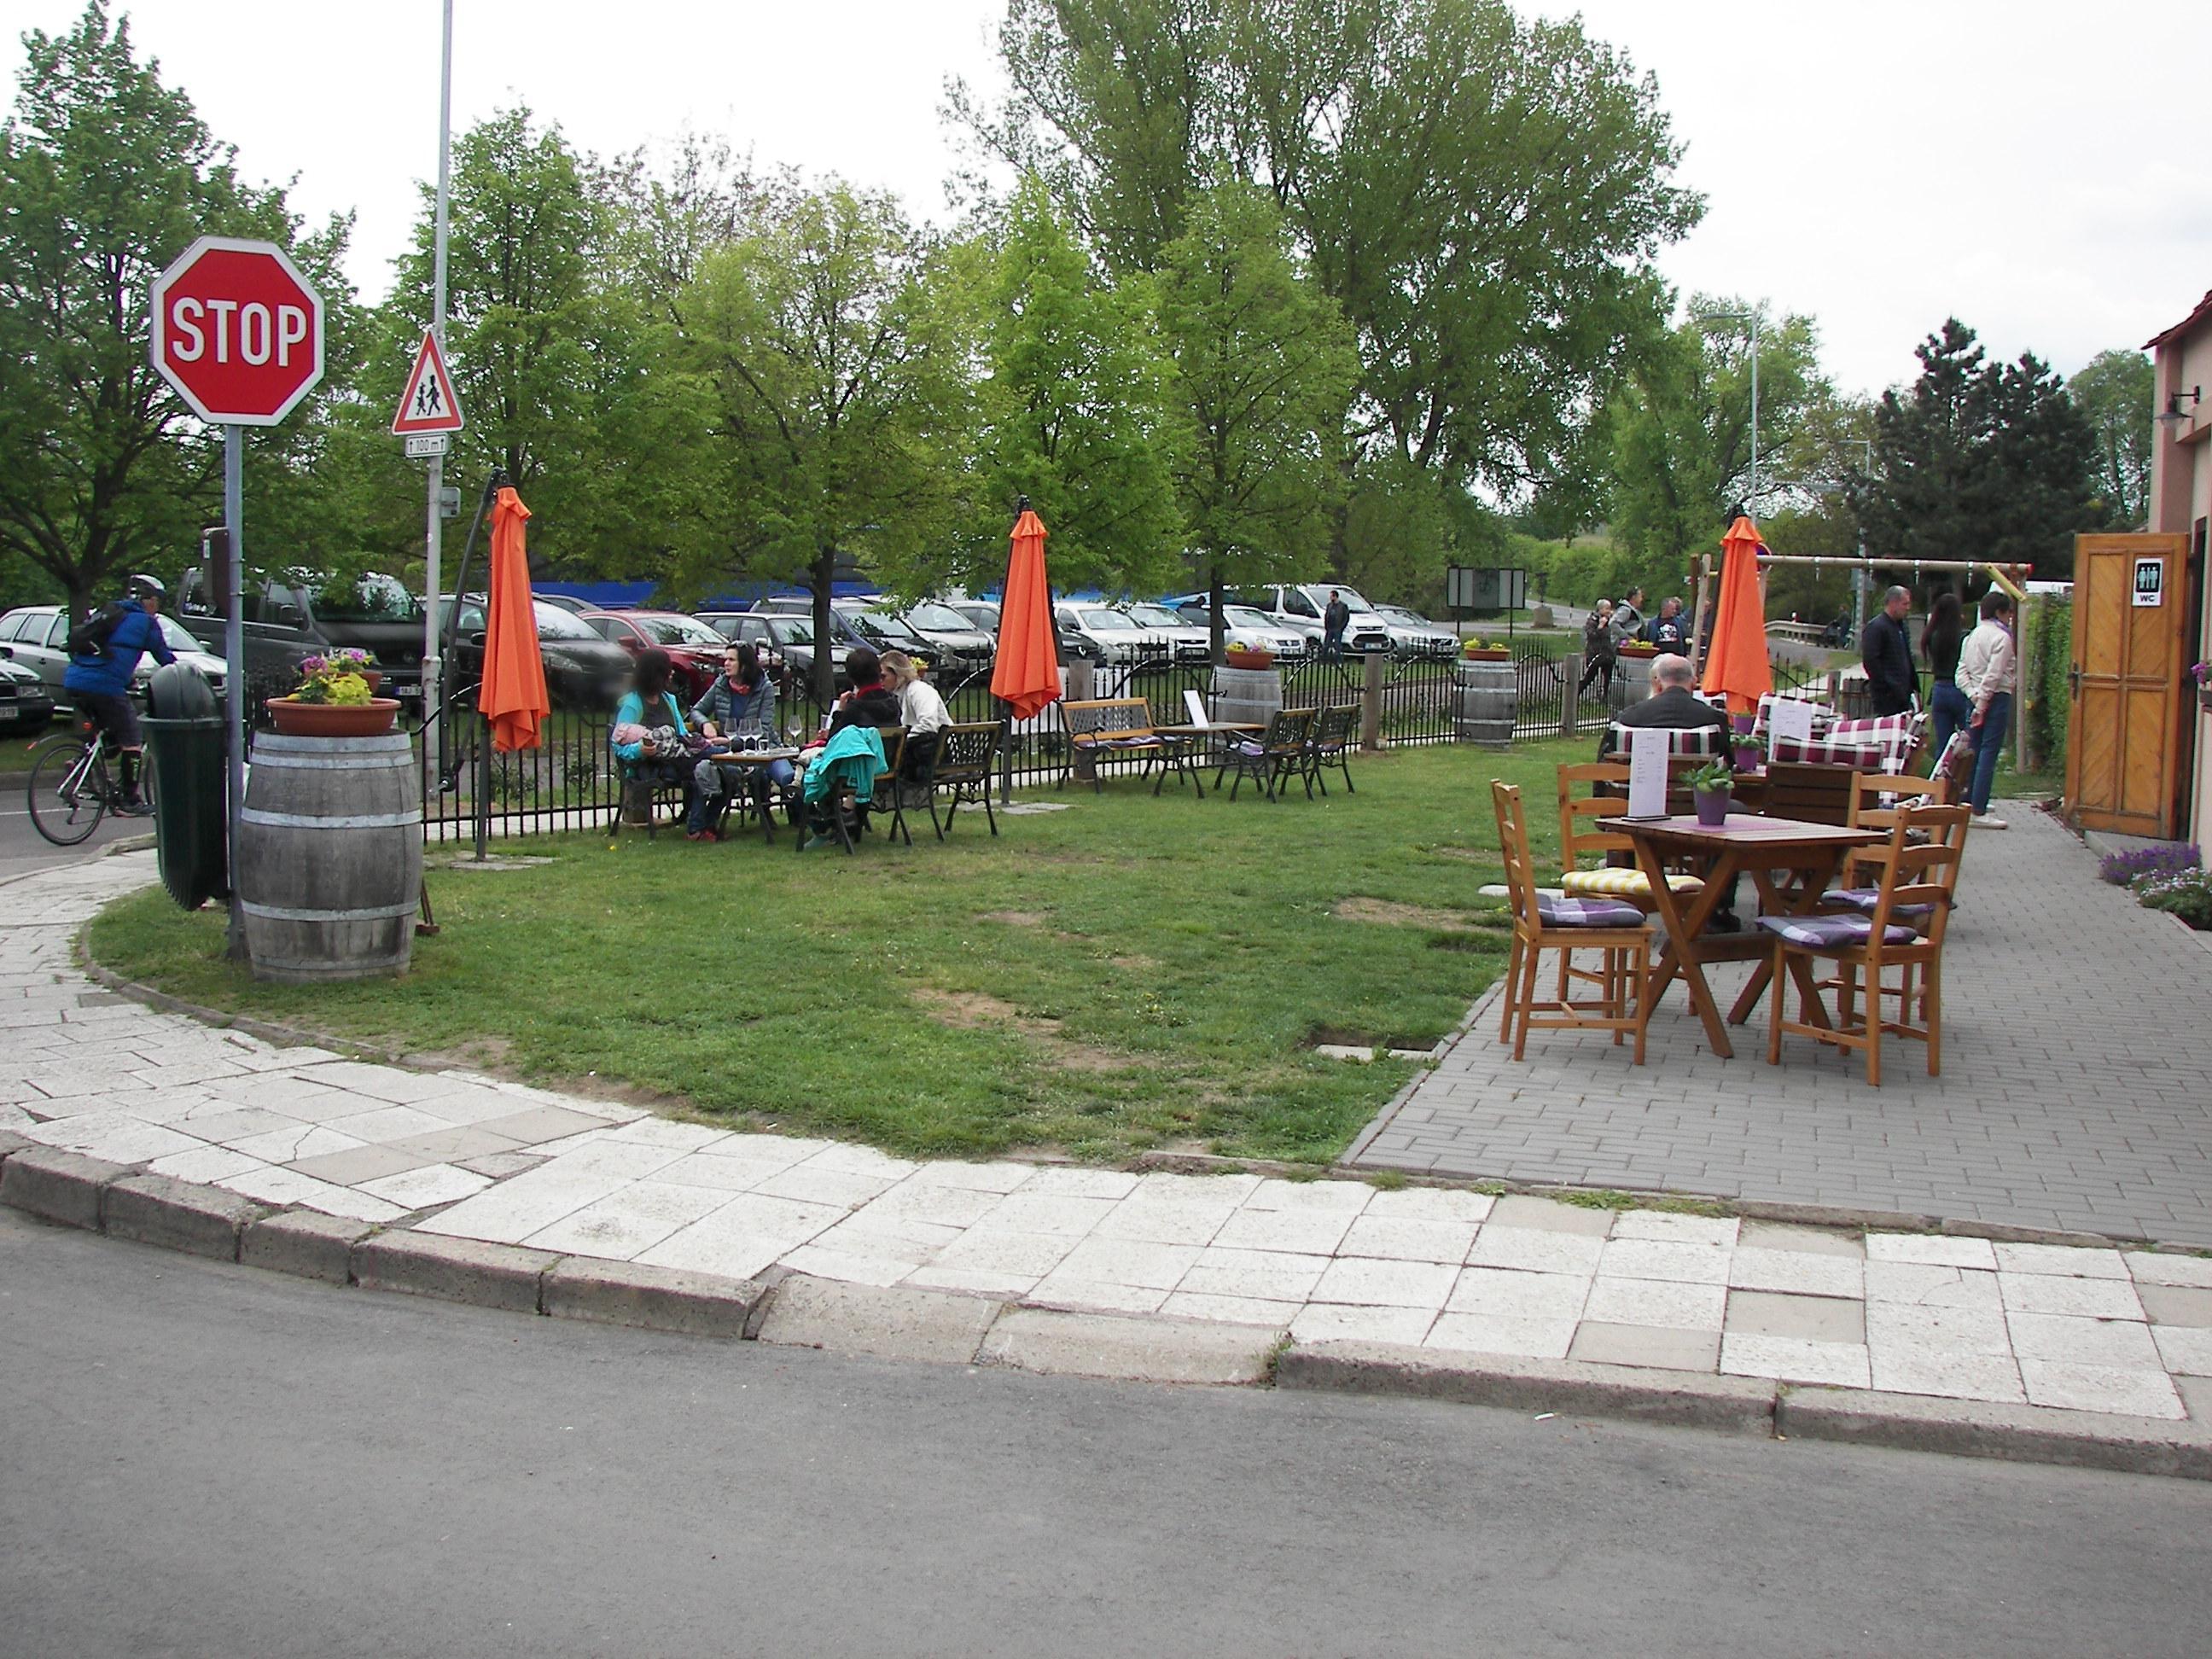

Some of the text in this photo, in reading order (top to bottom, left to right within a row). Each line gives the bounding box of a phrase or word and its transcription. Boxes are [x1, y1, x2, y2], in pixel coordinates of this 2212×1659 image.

[172, 296, 307, 367] STOP
[416, 439, 439, 451] 100 m
